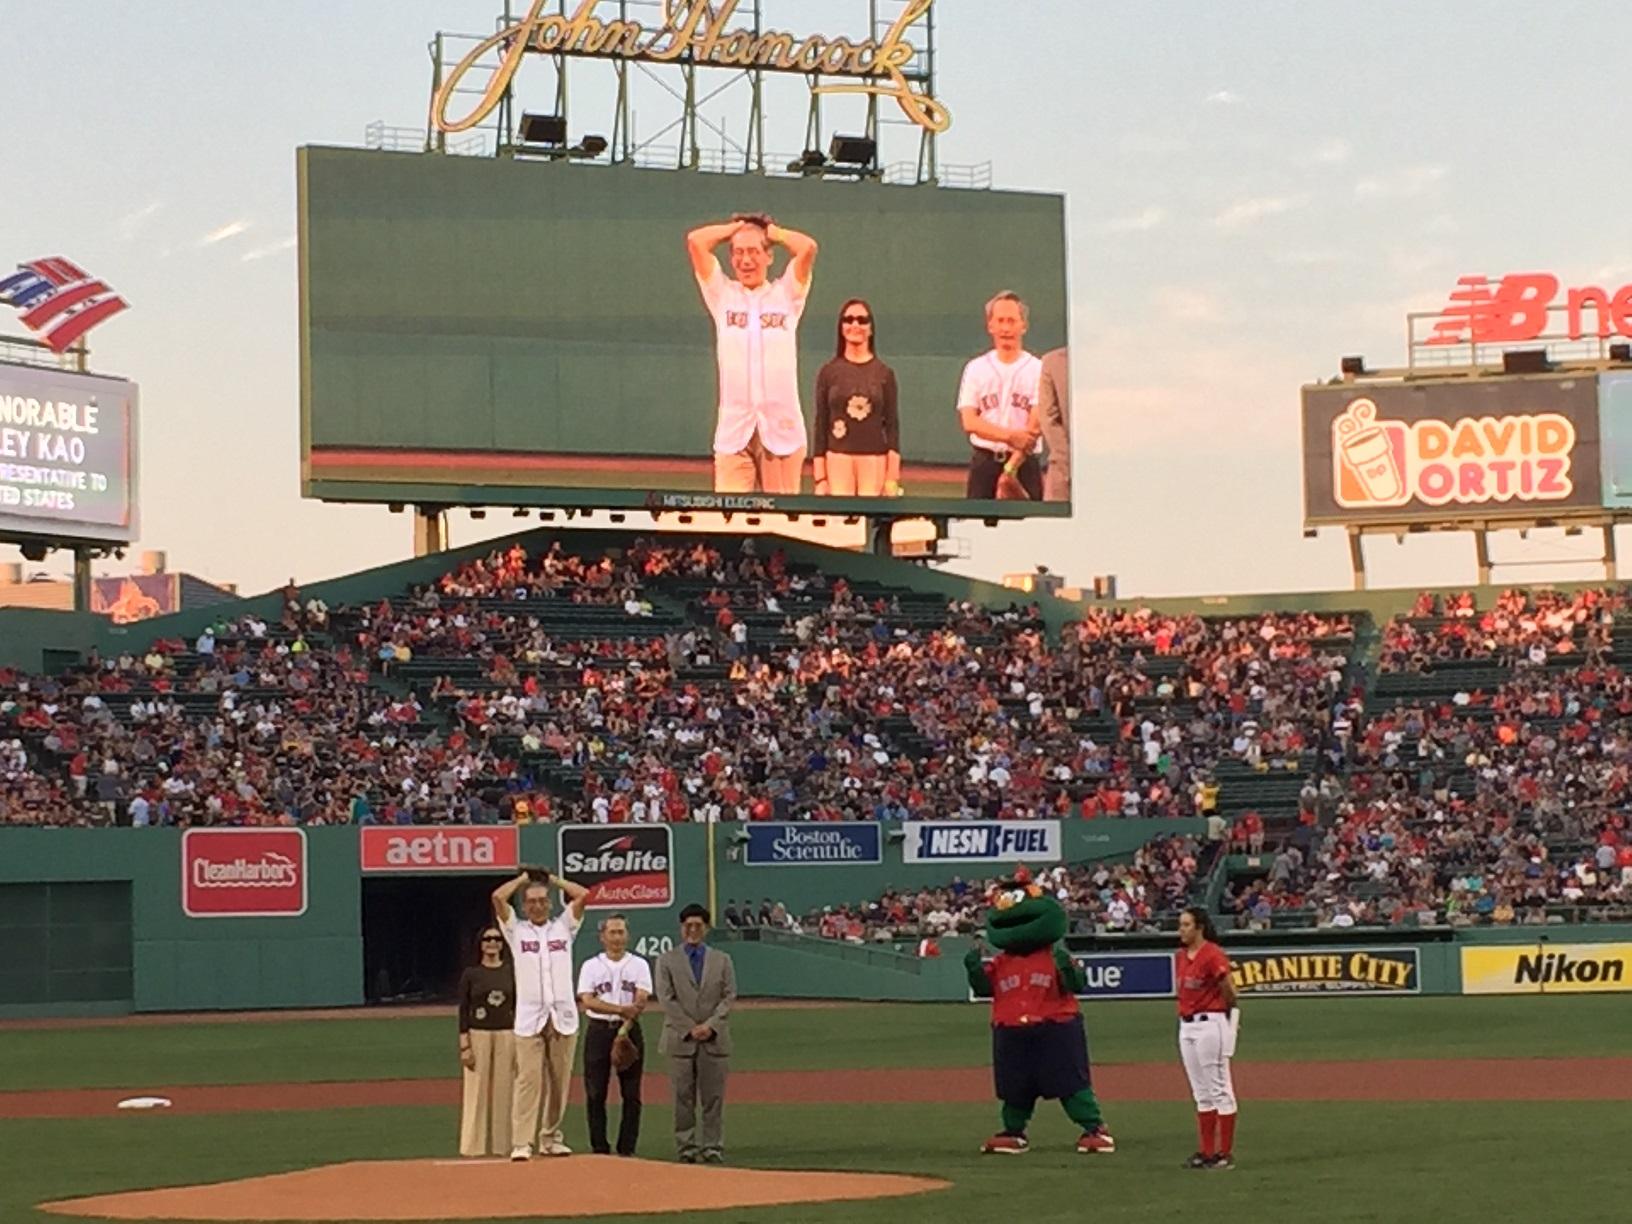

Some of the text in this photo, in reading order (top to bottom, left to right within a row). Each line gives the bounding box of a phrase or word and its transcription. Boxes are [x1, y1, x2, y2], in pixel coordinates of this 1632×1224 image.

[433, 0, 951, 132] John Hancock
[0, 428, 85, 464] EY KAO
[1418, 420, 1569, 460] DAVID
[90, 473, 107, 491] TO
[1418, 459, 1566, 498] ORTIZ
[23, 489, 74, 510] STATES
[386, 832, 494, 864] aetna
[772, 837, 863, 861] Scientific
[784, 827, 840, 844] Boston
[930, 828, 1049, 855] NESN FUEL
[565, 851, 667, 872] Safelite
[635, 936, 673, 956] 420
[1349, 953, 1414, 987] CITY
[1514, 953, 1624, 984] Nikon
